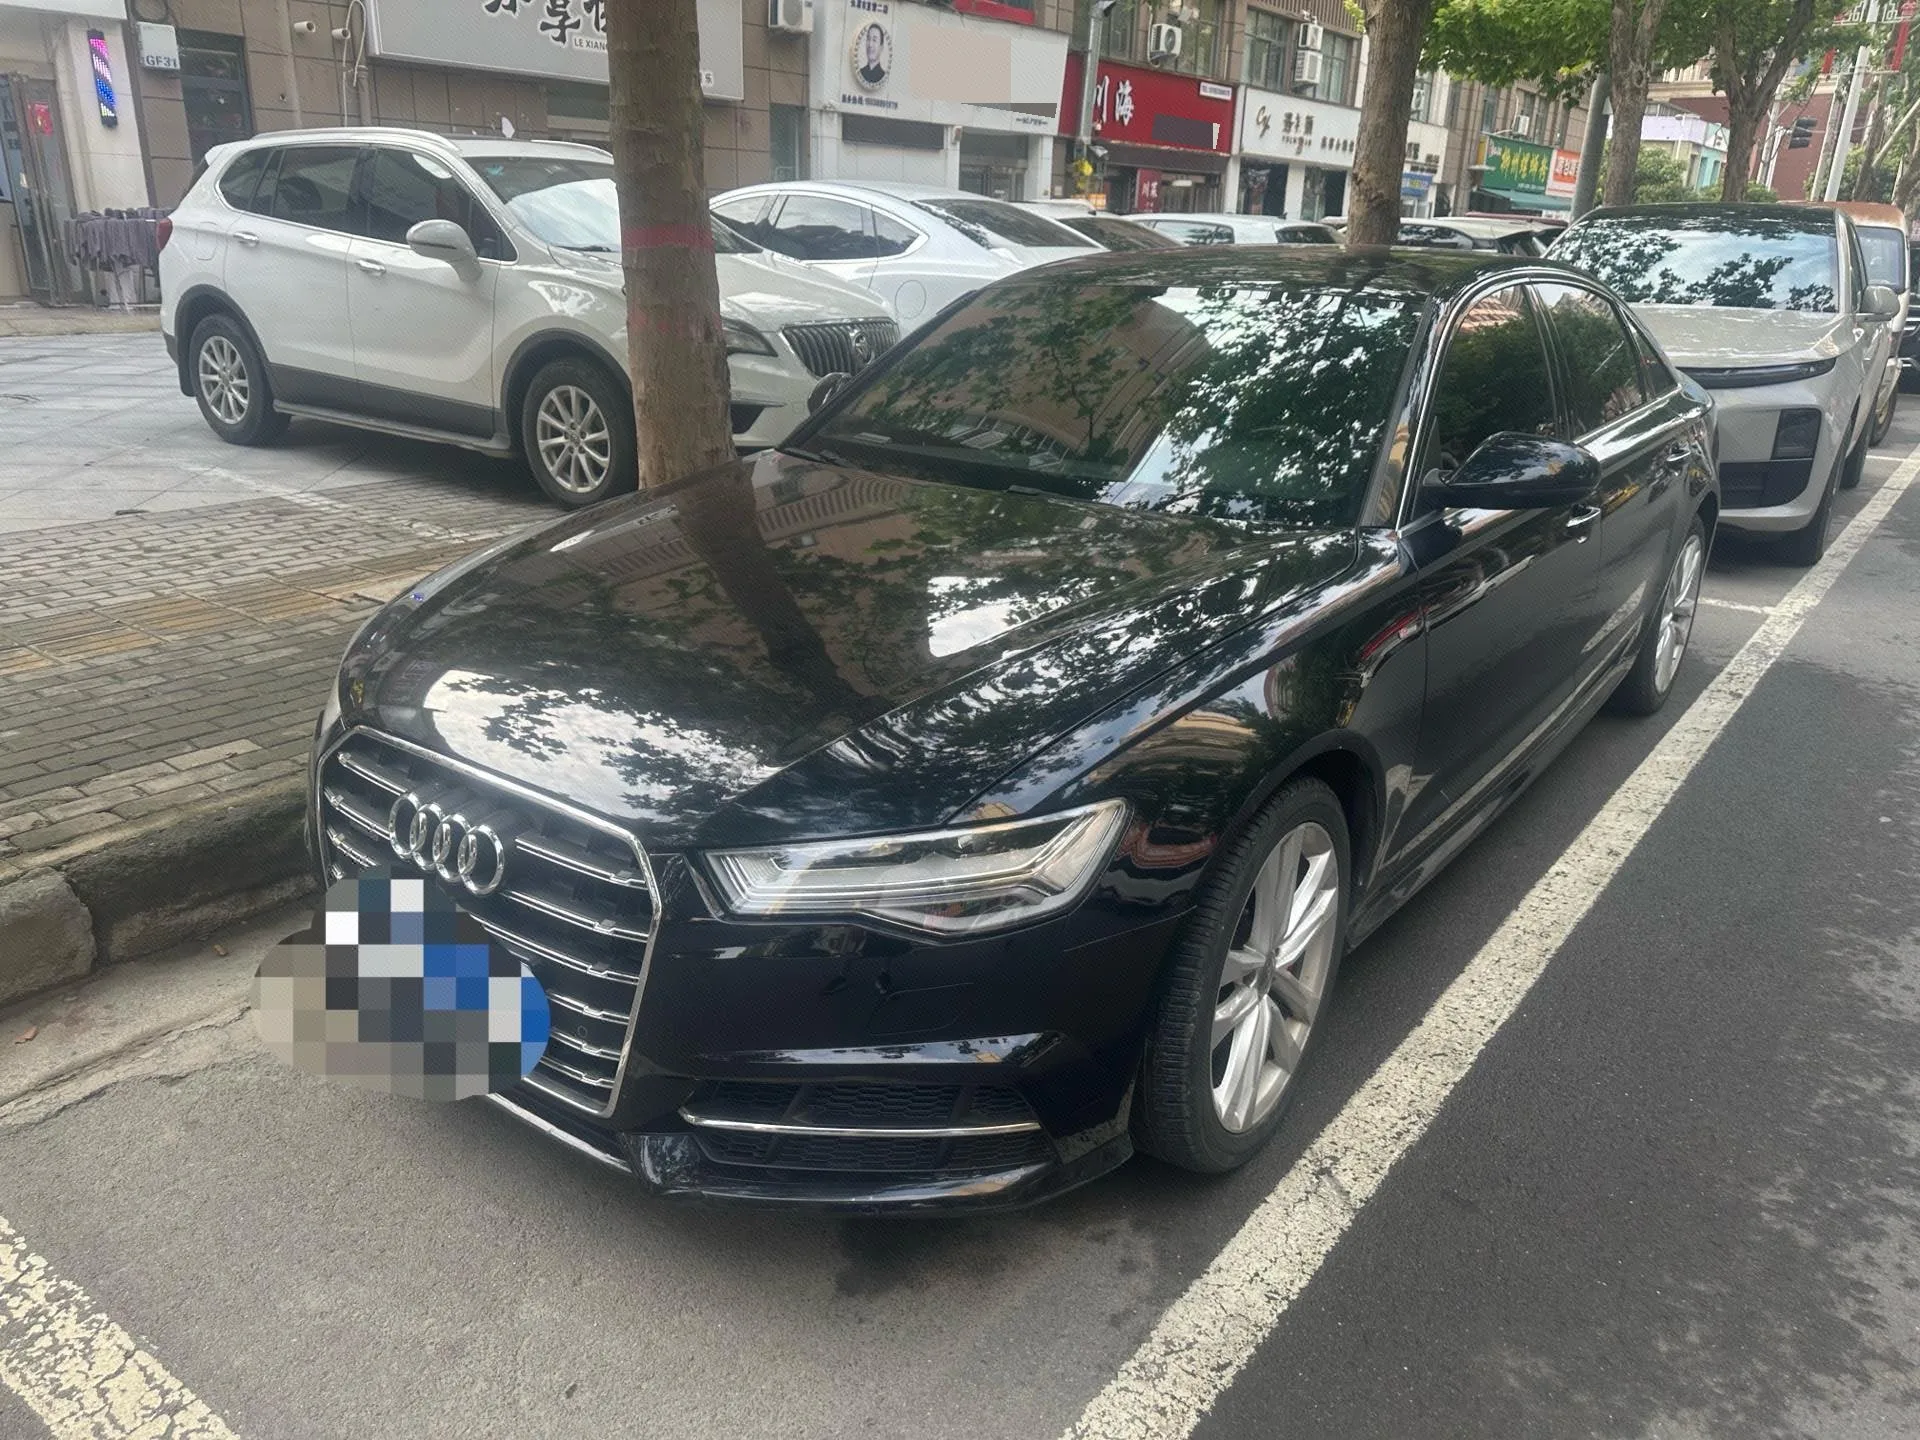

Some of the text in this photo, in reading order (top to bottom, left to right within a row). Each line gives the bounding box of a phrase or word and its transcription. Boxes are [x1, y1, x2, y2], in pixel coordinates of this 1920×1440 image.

[574, 37, 607, 50] LE XIAN
[145, 55, 178, 68] GF31
